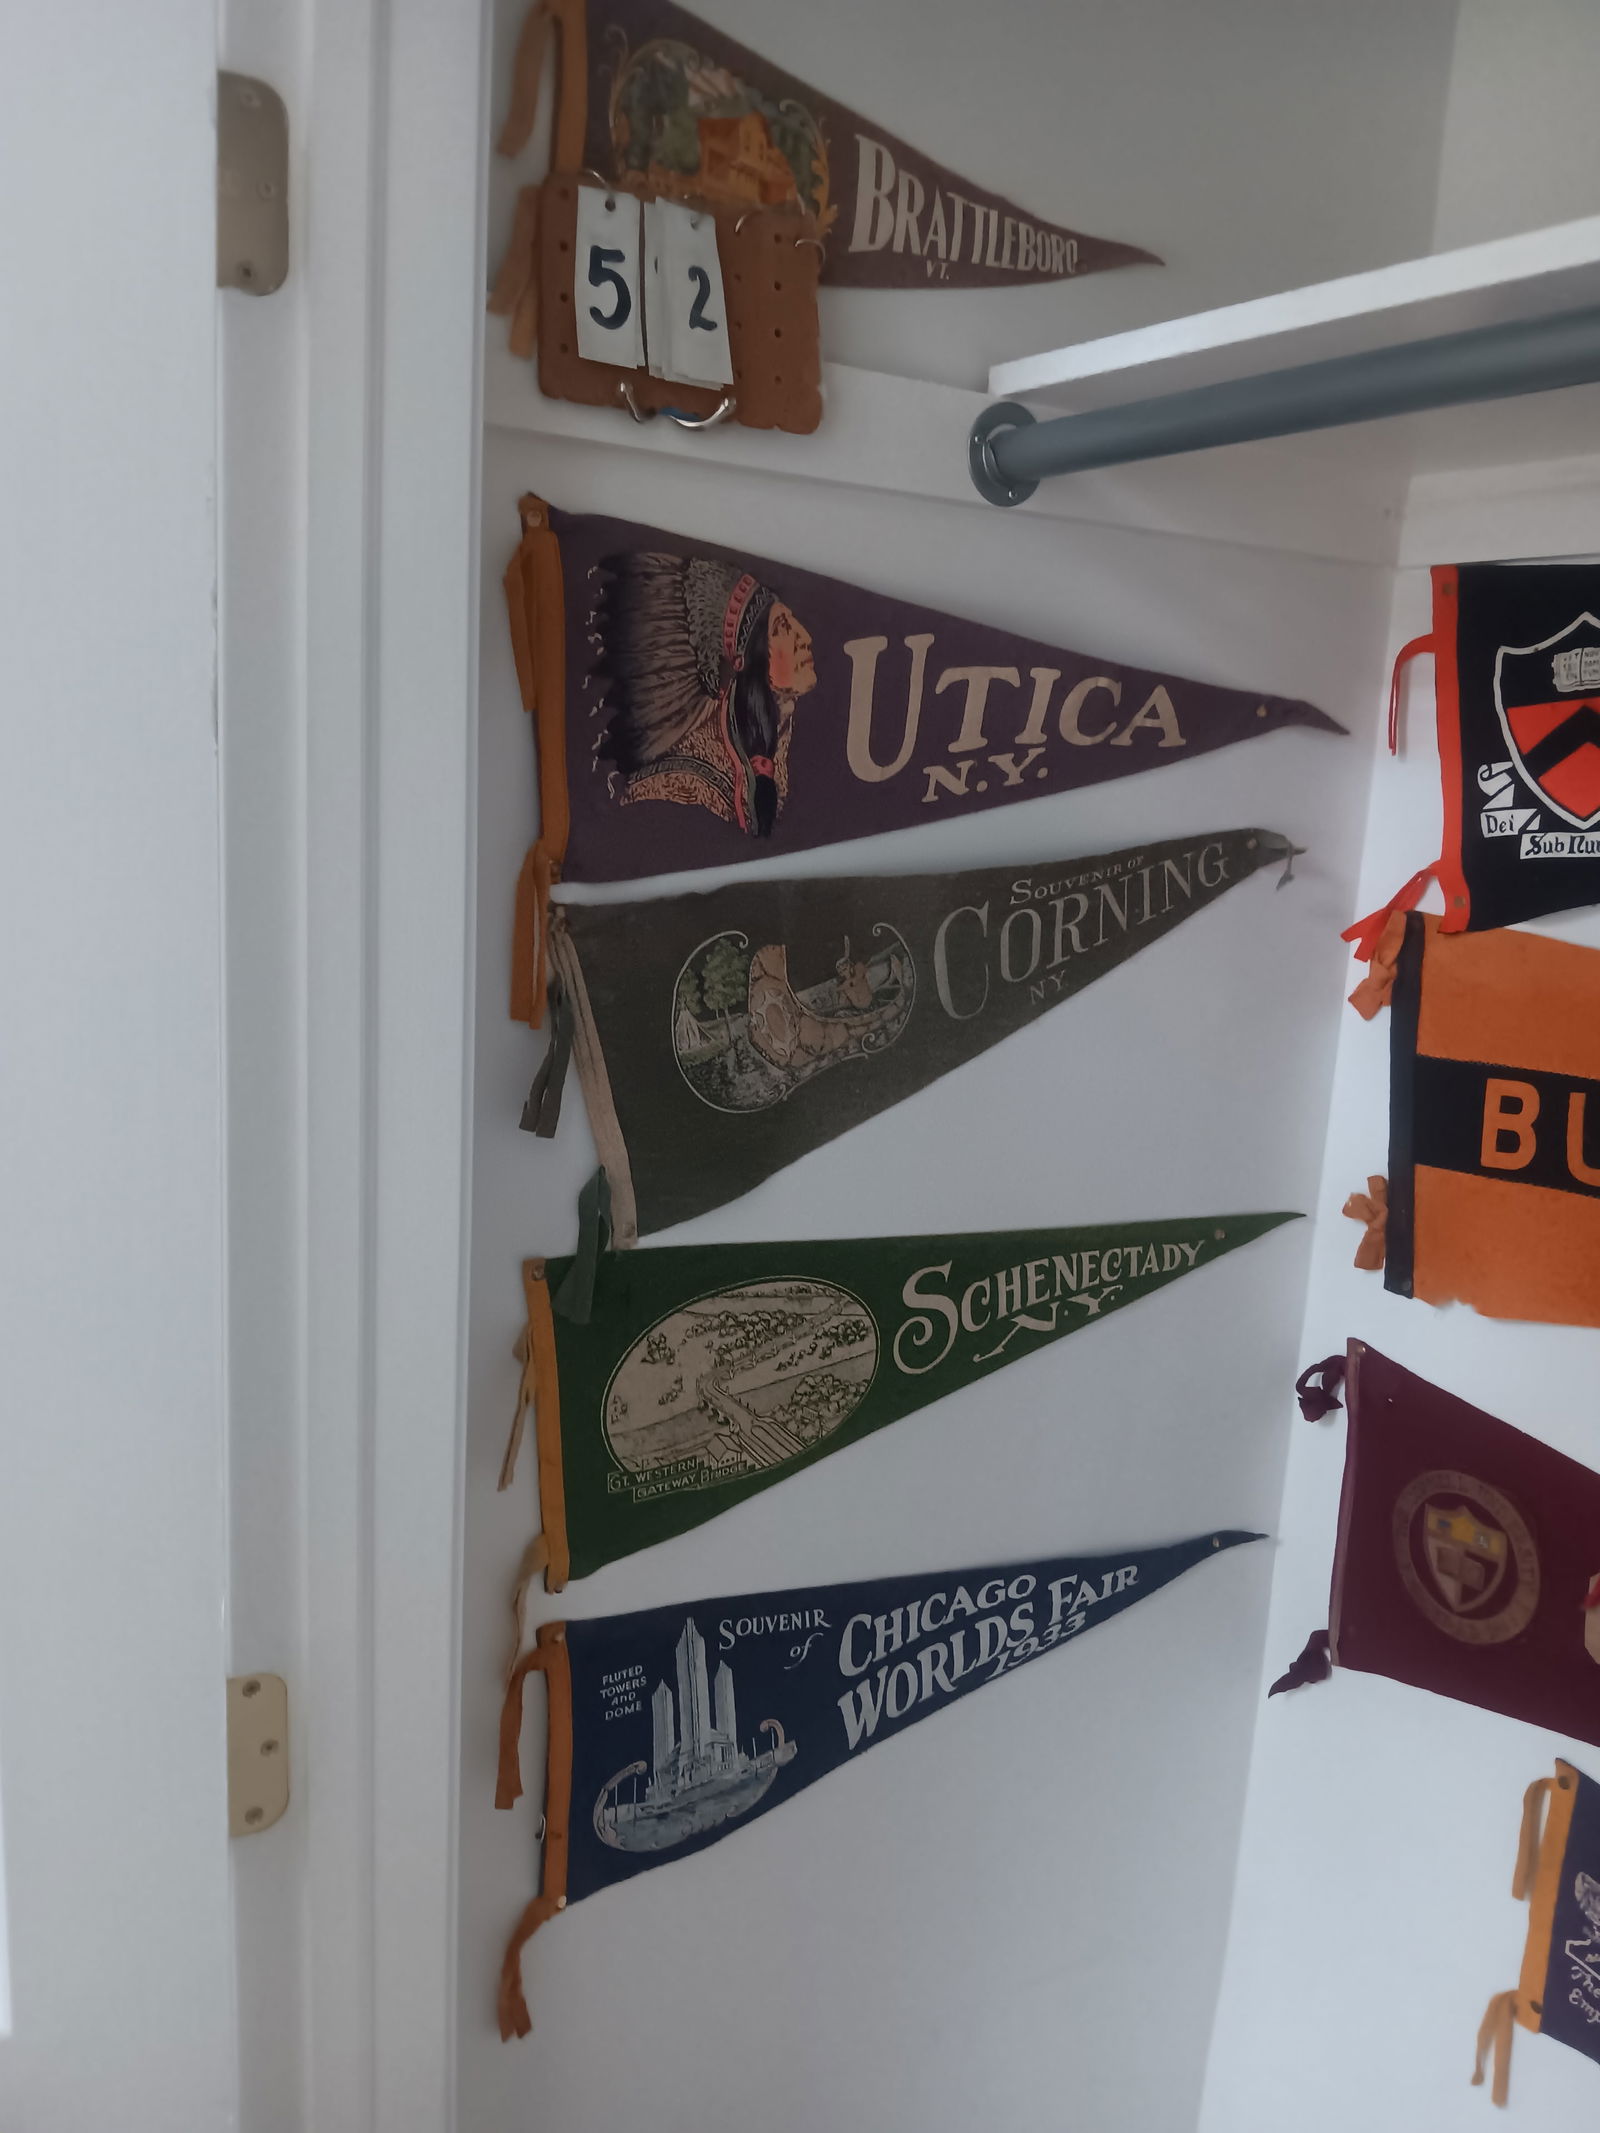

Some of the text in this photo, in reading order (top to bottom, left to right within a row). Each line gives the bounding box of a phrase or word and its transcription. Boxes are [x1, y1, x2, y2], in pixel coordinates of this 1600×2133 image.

[848, 133, 1079, 275] BRATTLEBORO
[588, 245, 718, 332] 5 2
[926, 259, 951, 281] VT.
[843, 633, 1187, 783] UTICA
[922, 747, 1049, 803] N.Y.
[1485, 813, 1515, 834] Dei
[1525, 833, 1600, 856] Sub Nu
[1009, 855, 1145, 906] SOUVENIR OF
[933, 842, 1230, 1020] CORNING
[893, 1240, 1205, 1375] SCHENECTADY
[972, 1284, 1124, 1363] N.Y.
[719, 1609, 832, 1651] SOUVENIR
[783, 1632, 825, 1670] of
[838, 1574, 1037, 1677] CHICAGO
[984, 1611, 1087, 1682] 1933
[602, 1664, 643, 1687] FLUTED
[837, 1565, 1140, 1751] WORLDS FAIR
[600, 1675, 647, 1699] TOWERS
[605, 1700, 642, 1721] DOME
